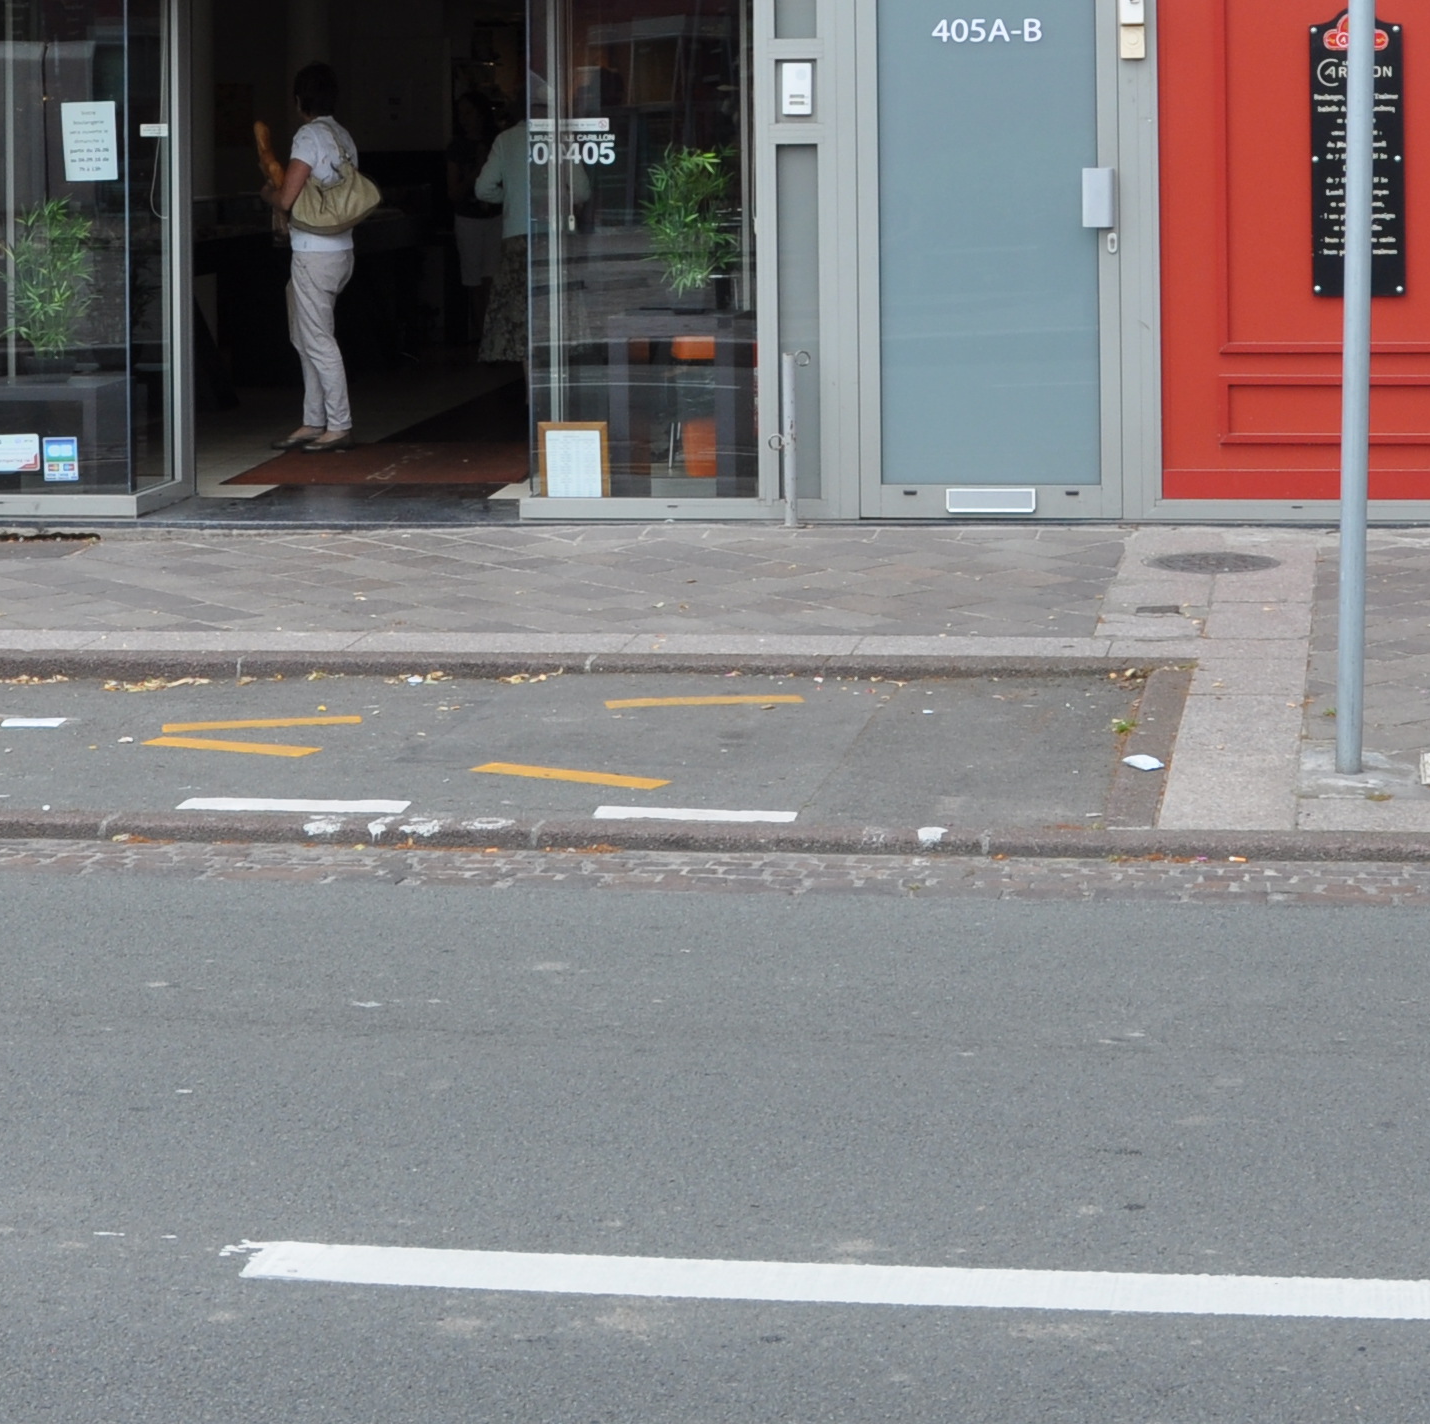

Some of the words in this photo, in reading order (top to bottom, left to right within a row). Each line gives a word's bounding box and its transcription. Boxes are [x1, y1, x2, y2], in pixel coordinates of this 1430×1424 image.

[931, 18, 1043, 44] 405A-B
[1316, 58, 1393, 87] CARON
[565, 142, 616, 165] 405
